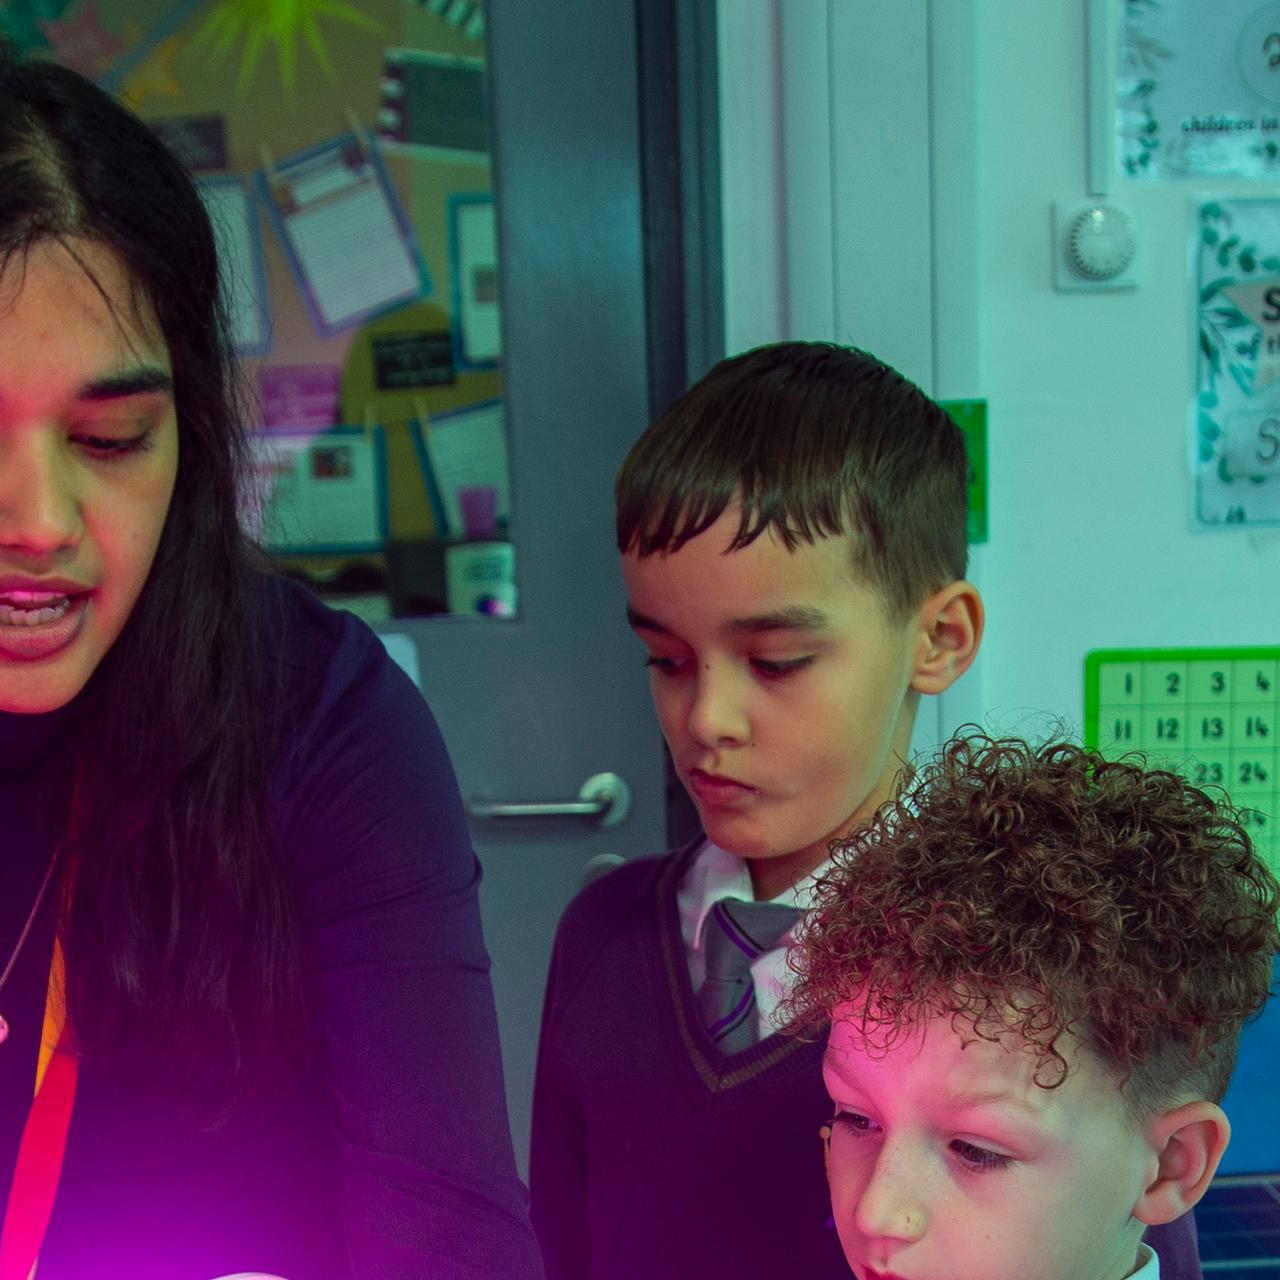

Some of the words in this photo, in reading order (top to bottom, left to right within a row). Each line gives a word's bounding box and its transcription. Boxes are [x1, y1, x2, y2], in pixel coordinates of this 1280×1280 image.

[1182, 114, 1255, 132] children
[1261, 114, 1279, 131] in
[1235, 331, 1262, 360] of
[1123, 672, 1133, 694] 1
[1166, 672, 1181, 694] 2
[1211, 671, 1225, 694] 3
[1256, 670, 1271, 693] 4
[1114, 718, 1133, 741] 11
[1156, 717, 1180, 740] 12
[1202, 717, 1225, 739] 13
[1246, 715, 1270, 738] 14
[1194, 762, 1224, 784] 23
[1239, 761, 1269, 784] 24
